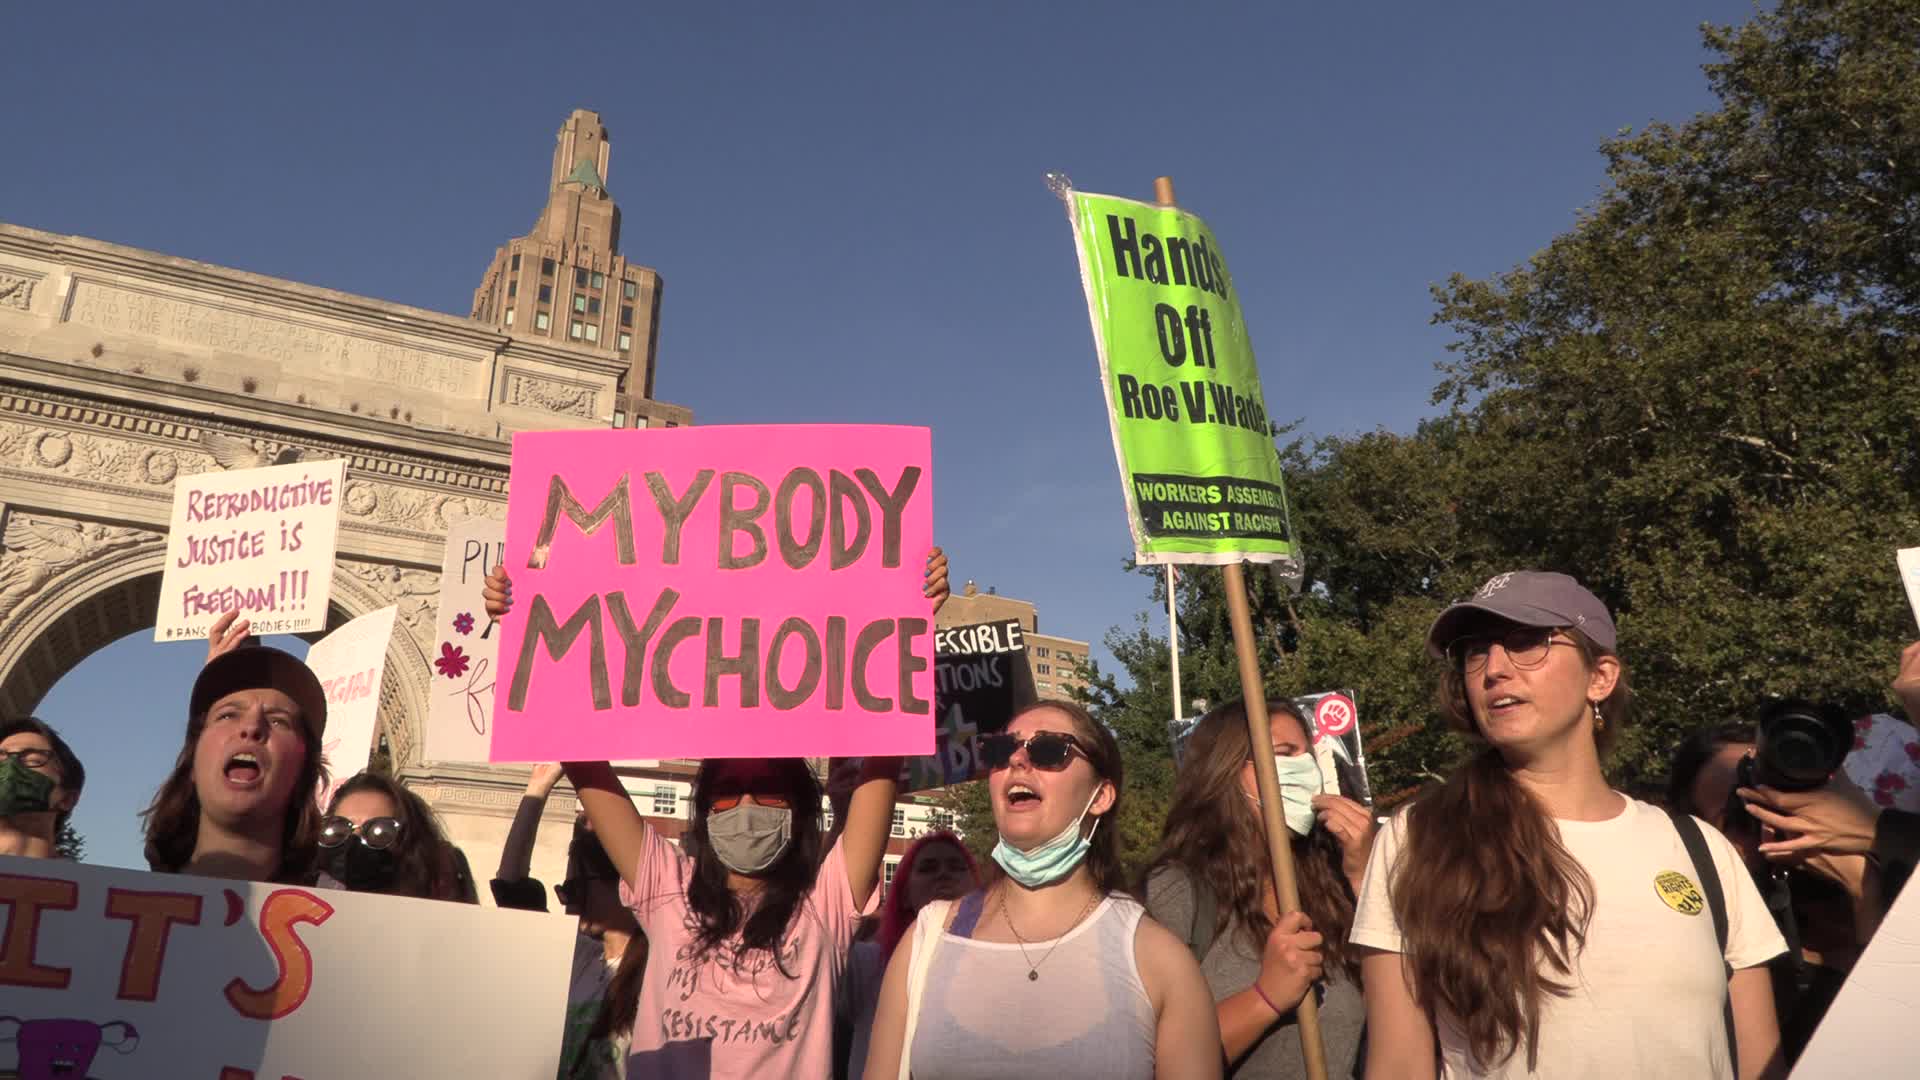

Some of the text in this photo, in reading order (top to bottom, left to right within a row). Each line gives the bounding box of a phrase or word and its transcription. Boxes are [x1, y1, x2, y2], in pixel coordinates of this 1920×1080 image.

[1106, 214, 1228, 301] Hands
[1155, 302, 1216, 369] Off
[1118, 374, 1179, 423] Roe
[1136, 481, 1222, 504] WORKERS
[1162, 510, 1282, 534] AGAINST RACISM
[935, 656, 1004, 696] TIONS
[0, 873, 335, 1021] IT'S
